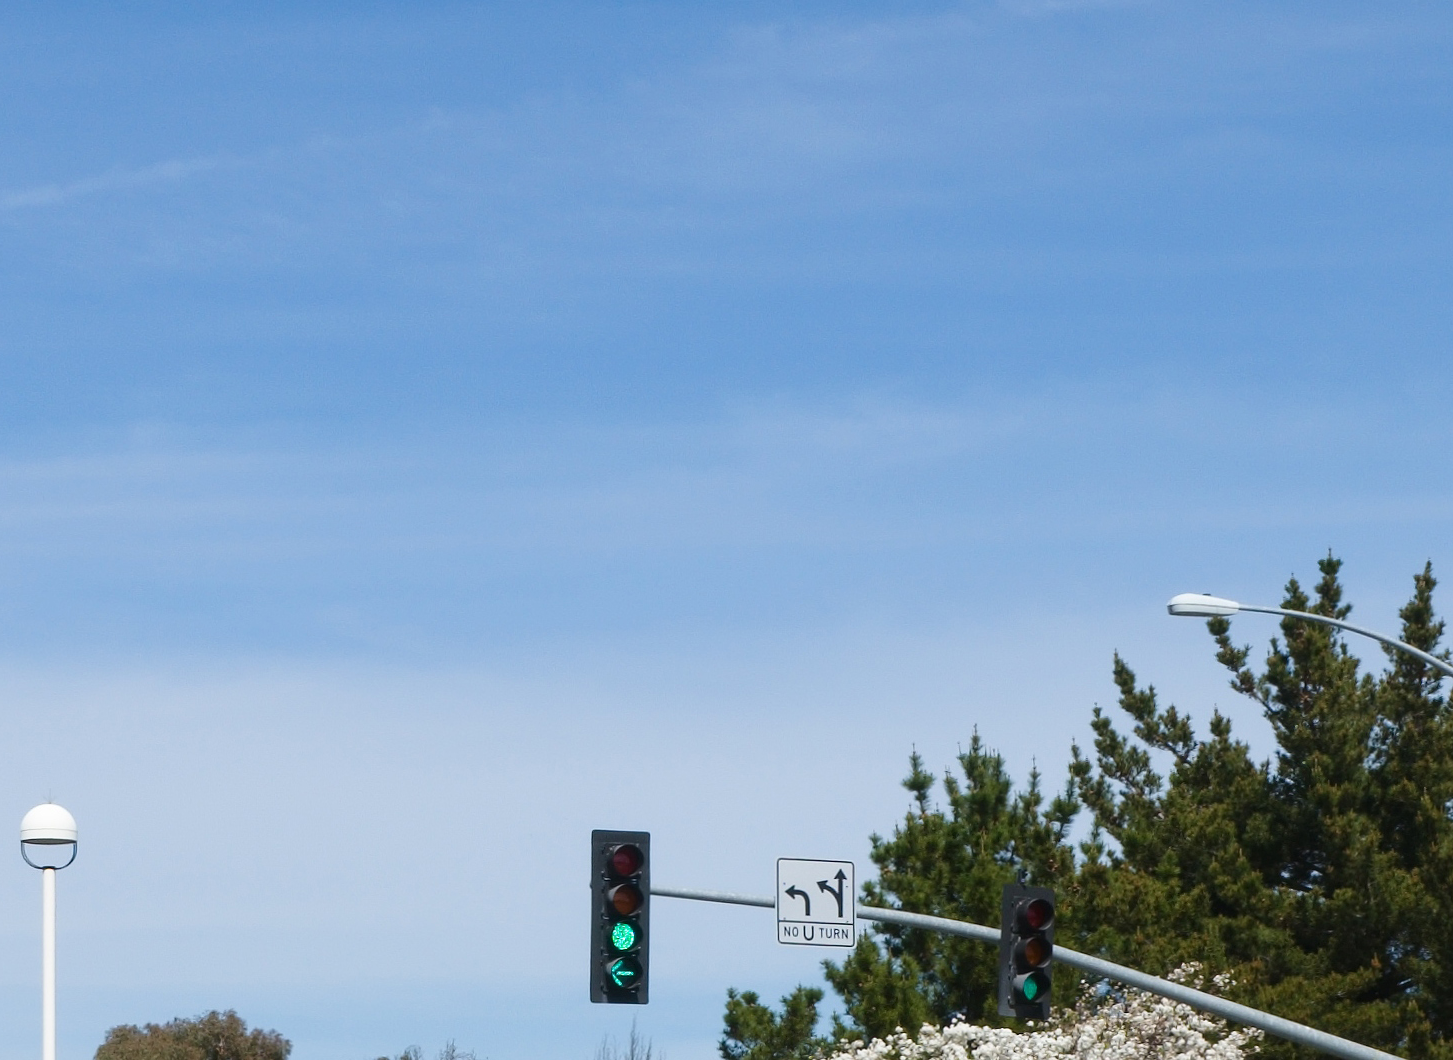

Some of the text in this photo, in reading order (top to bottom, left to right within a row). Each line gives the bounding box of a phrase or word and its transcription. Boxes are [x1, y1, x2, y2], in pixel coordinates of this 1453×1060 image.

[783, 925, 849, 941] NO U TURN
